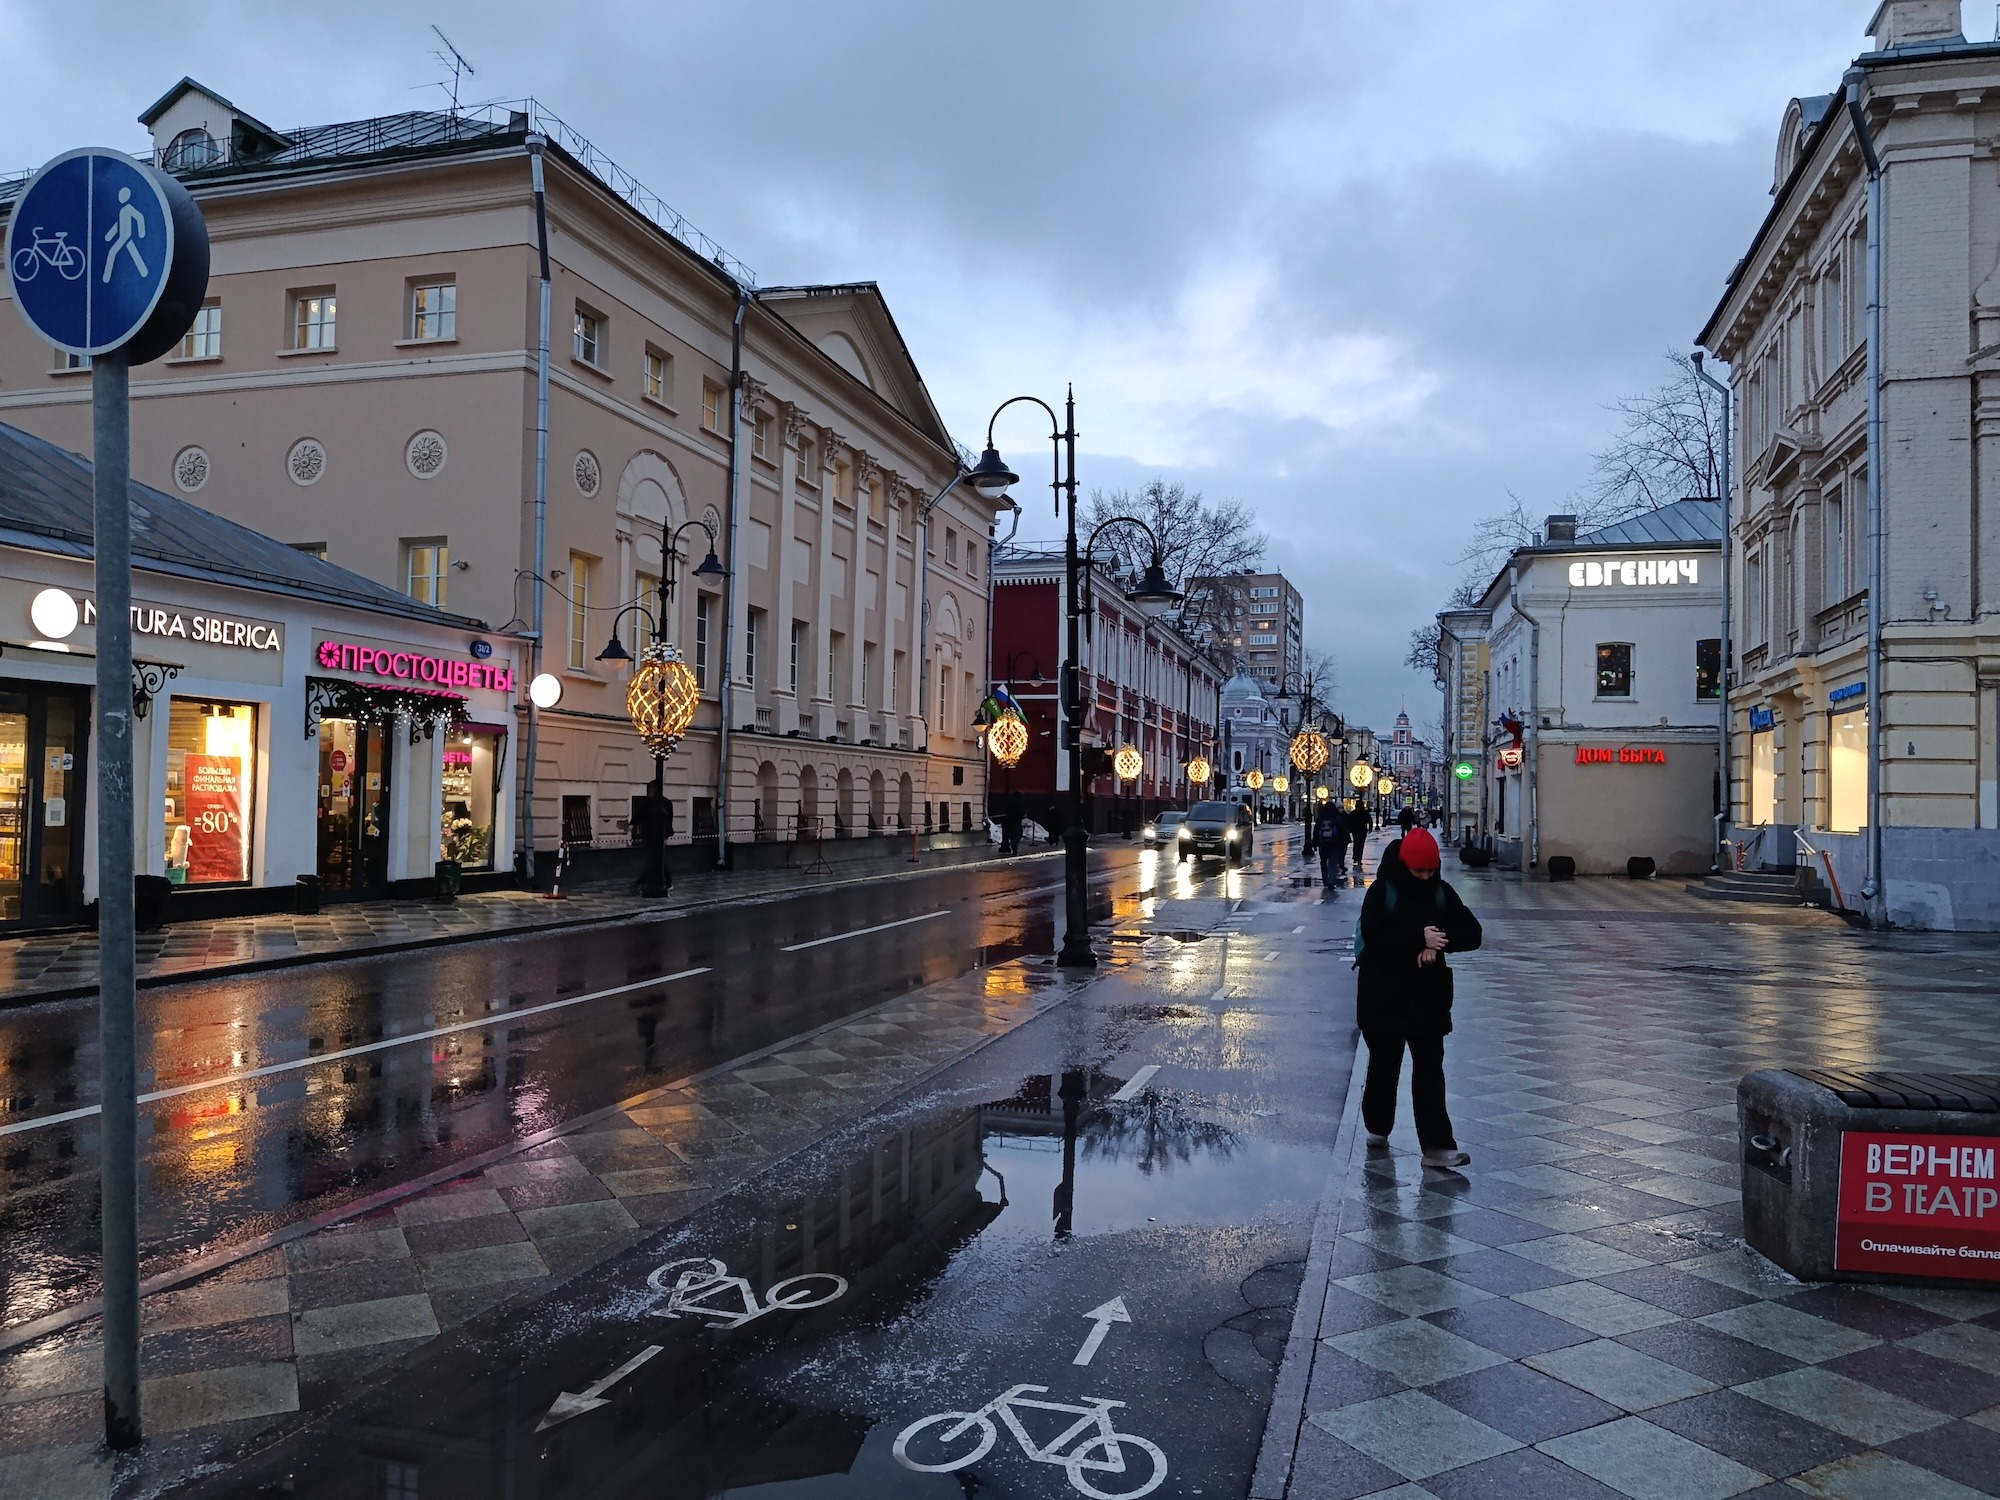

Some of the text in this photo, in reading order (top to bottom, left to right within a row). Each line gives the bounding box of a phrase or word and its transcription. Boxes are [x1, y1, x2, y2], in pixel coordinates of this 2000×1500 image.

[1568, 559, 1698, 587] ЕВГЕНИЧ
[84, 598, 281, 651] NTURA SIBERICA
[341, 644, 515, 692] ПРОСТОЦВЕТЫ
[1576, 748, 1666, 765] ДОМ БЫТА
[193, 774, 236, 784] ФИНАЛЬНАЯ
[198, 766, 231, 775] БОЛЬШАЯ
[191, 783, 238, 793] РАСПРОДАЖА
[1866, 1143, 1995, 1180] ВЕРНЕМ
[1865, 1182, 1999, 1218] В ТЕАТР
[1860, 1238, 1956, 1257] Оплачивайте
